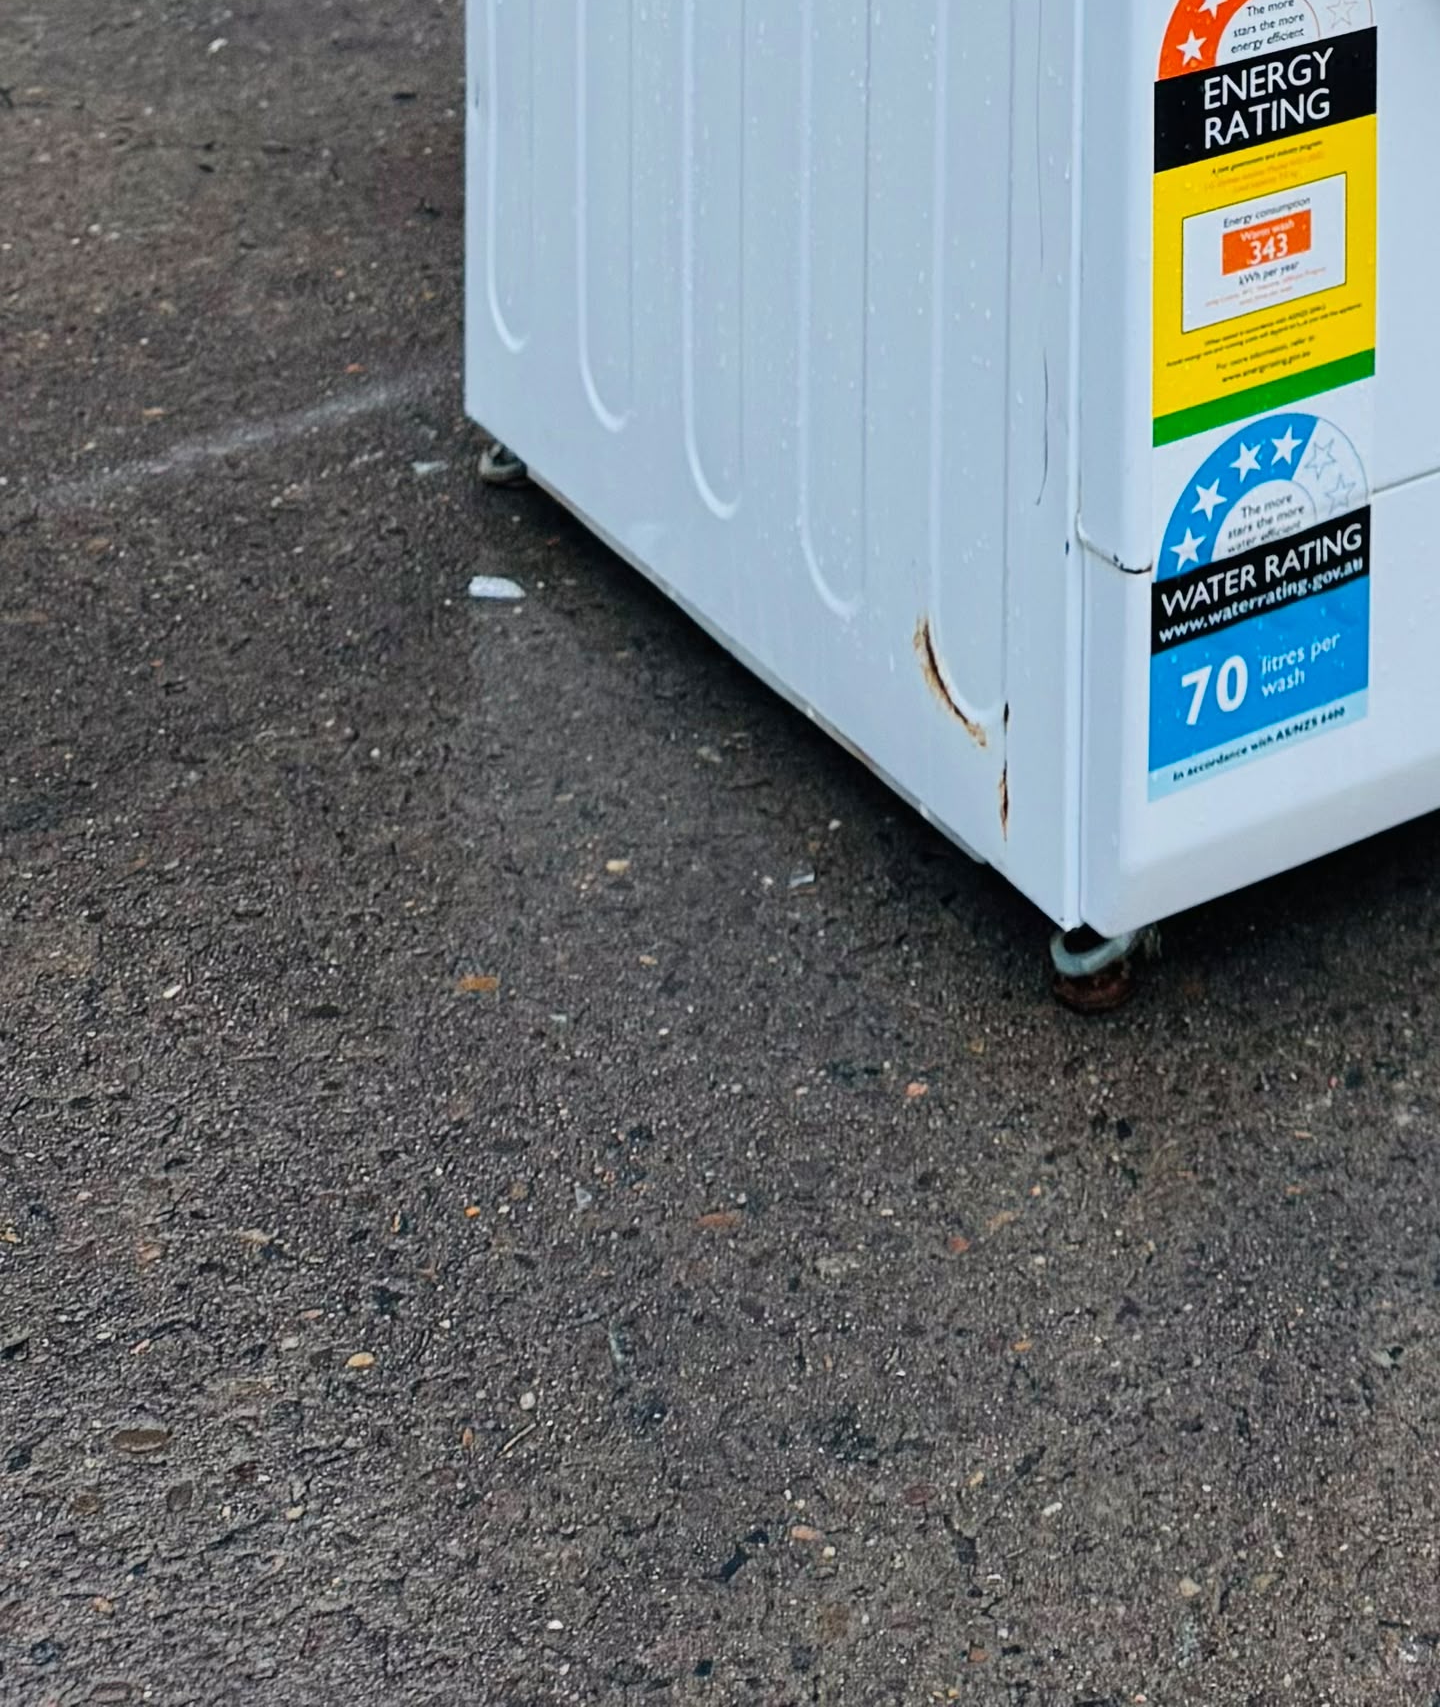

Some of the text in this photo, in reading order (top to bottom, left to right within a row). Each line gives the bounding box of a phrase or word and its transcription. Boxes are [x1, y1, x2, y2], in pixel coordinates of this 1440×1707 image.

[1247, 0, 1294, 17] The more
[1233, 13, 1304, 38] stars the more
[1231, 28, 1304, 54] energy efficient
[1203, 47, 1334, 110] ENERGY
[1204, 88, 1330, 149] RATING
[1223, 197, 1311, 228] Energy consumption
[1249, 232, 1288, 265] 343
[1238, 271, 1262, 286] kWh
[1263, 268, 1278, 281] per
[1280, 261, 1300, 276] year
[1242, 495, 1292, 518] The more
[1257, 516, 1273, 529] the
[1277, 506, 1304, 521] more
[1228, 537, 1256, 553] water
[1161, 523, 1362, 617] WATER RATING
[1159, 557, 1363, 643] www.waterrating.gov.au
[1181, 633, 1341, 726] 70 litres per
[1261, 669, 1306, 697] wash
[1187, 747, 1247, 776] accordance
[1251, 736, 1274, 751] with
